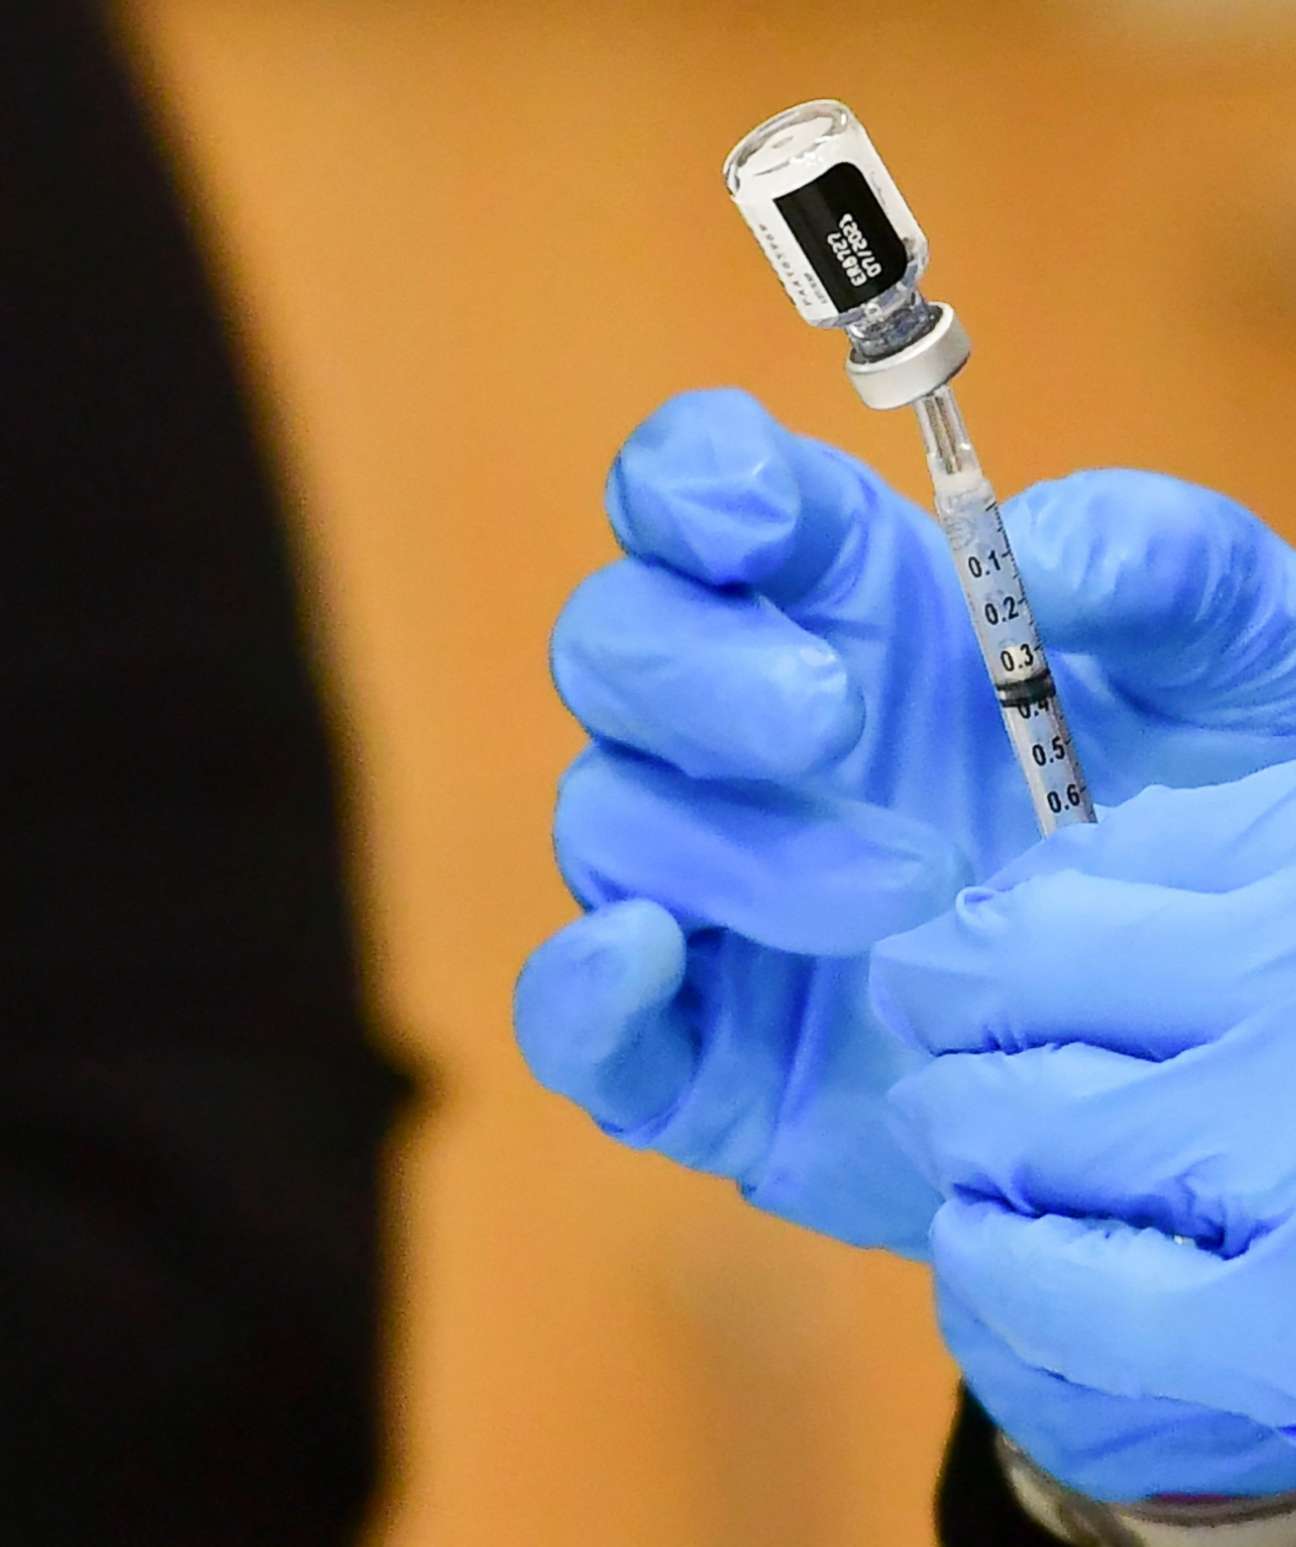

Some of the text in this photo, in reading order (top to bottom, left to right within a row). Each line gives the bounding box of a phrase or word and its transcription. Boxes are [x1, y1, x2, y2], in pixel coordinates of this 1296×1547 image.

[968, 550, 1001, 578] 0.1
[985, 596, 1018, 625] 0.2
[1001, 644, 1034, 672] 0.3
[1033, 737, 1065, 767] 0.5
[1047, 784, 1080, 813] 0.6
